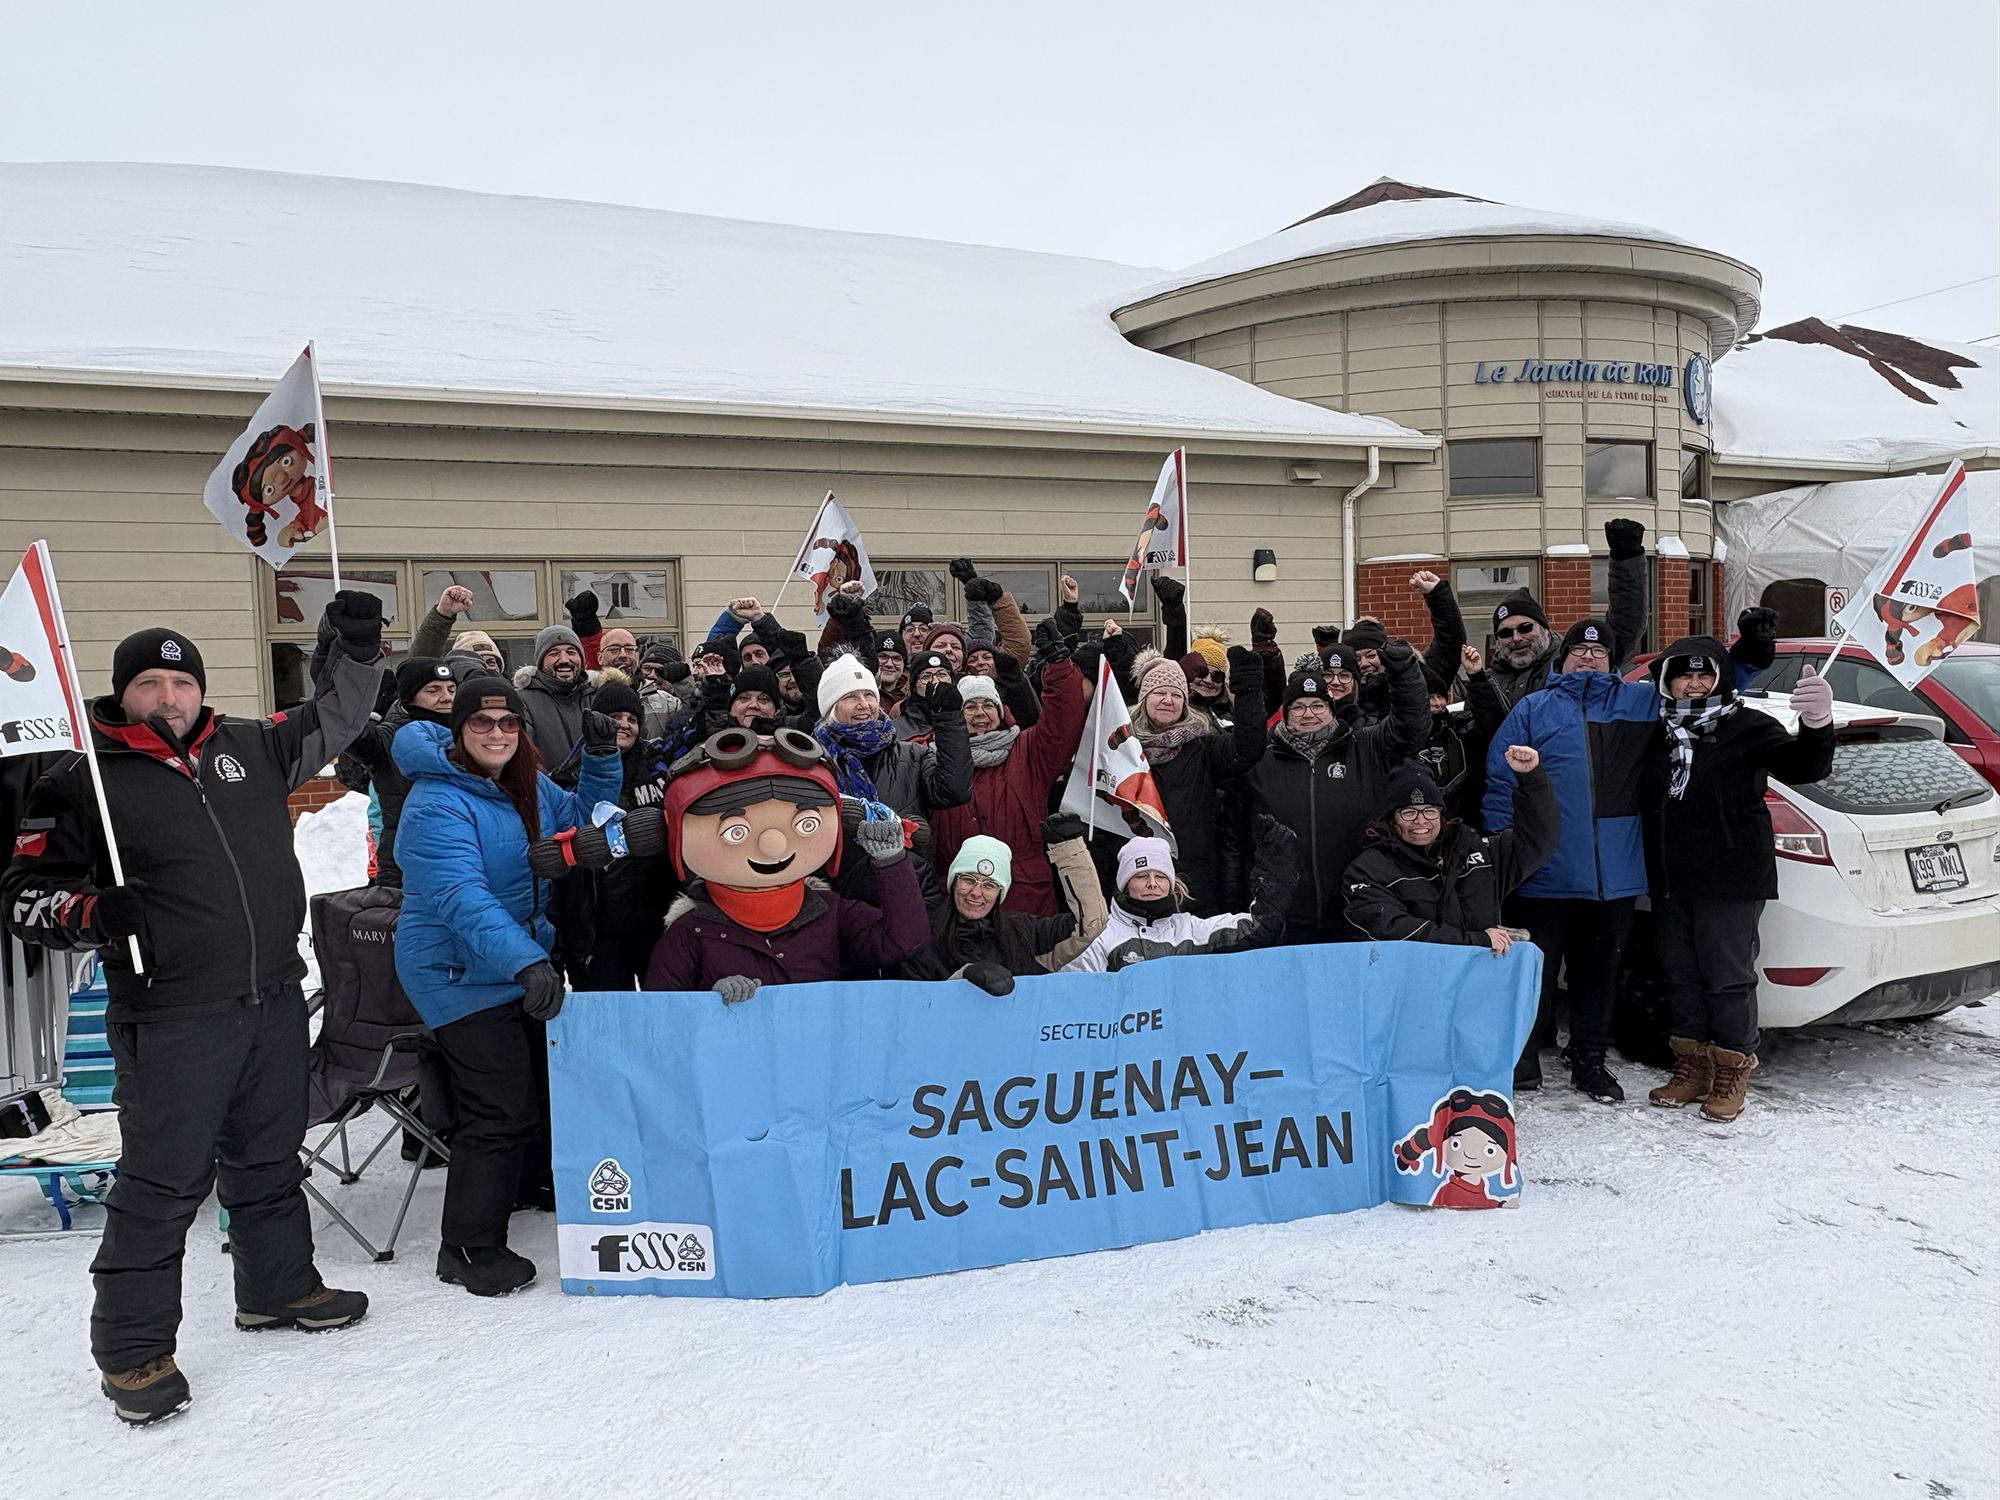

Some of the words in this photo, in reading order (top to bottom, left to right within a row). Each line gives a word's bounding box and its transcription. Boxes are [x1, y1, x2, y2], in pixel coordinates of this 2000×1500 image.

[1475, 361, 1508, 384] Le
[1514, 357, 1599, 384] Jardin
[1602, 361, 1631, 384] de
[1601, 390, 1613, 399] LA
[1911, 859, 1936, 880] K99
[1938, 855, 1963, 877] NXL
[352, 929, 387, 945] MARY
[1040, 1021, 1119, 1042] SECTEUR
[1120, 1008, 1163, 1035] CPE
[840, 1110, 1354, 1230] LAC-SAINT-JEAN
[592, 1197, 629, 1211] CSN
[677, 1261, 706, 1272] CSN
